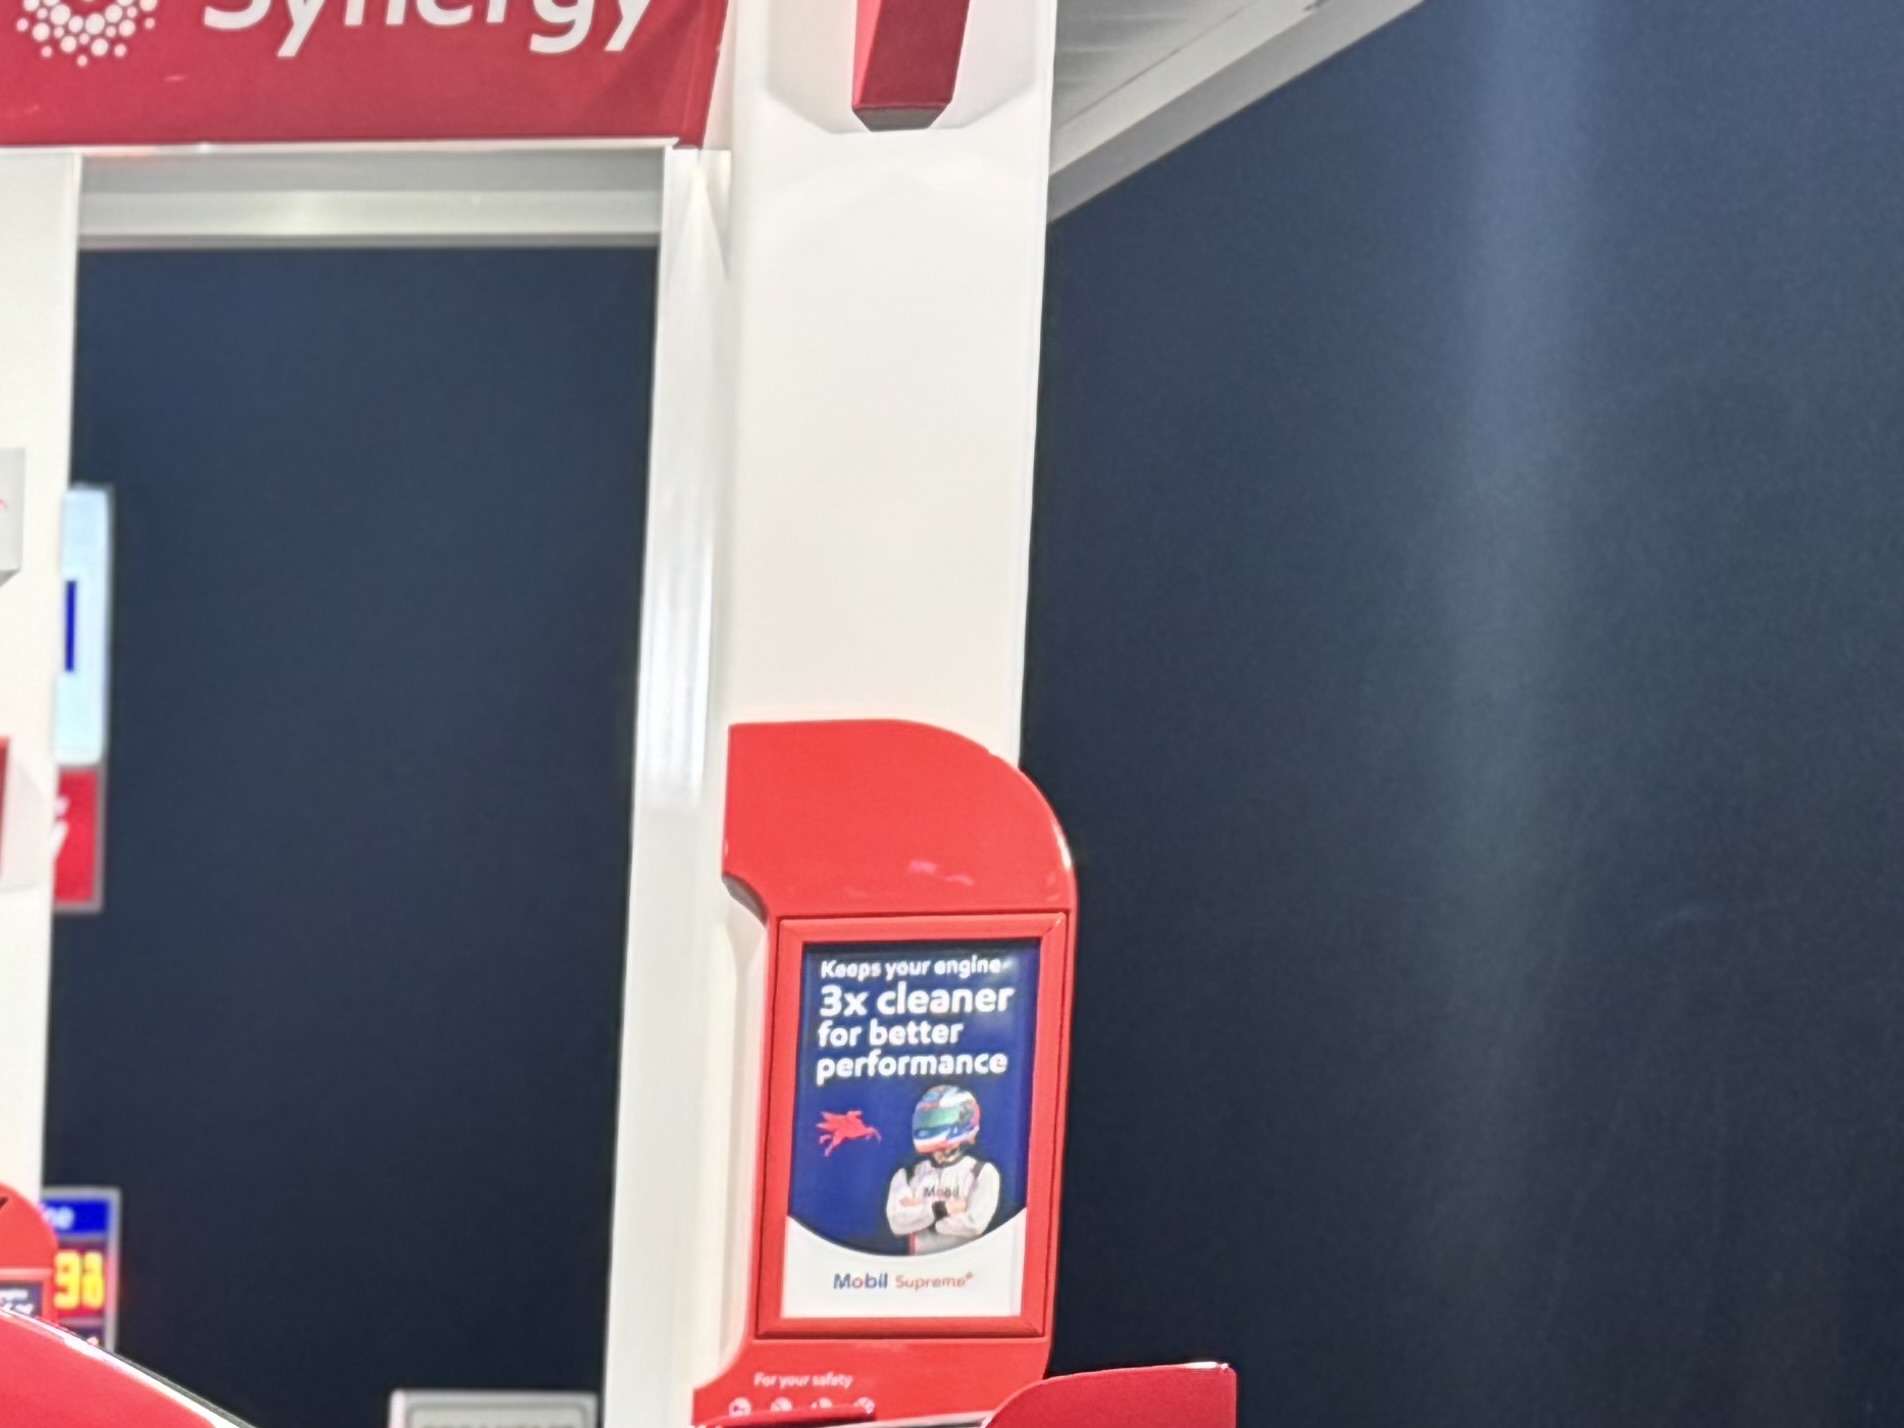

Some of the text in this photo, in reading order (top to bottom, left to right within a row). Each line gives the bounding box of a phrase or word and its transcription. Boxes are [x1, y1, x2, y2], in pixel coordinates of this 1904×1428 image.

[820, 954, 1002, 982] Keeps your engine
[819, 981, 1016, 1017] 3x cleaner
[817, 1018, 964, 1048] for better
[816, 1049, 1008, 1087] performance
[833, 1272, 889, 1290] Mobil
[753, 1370, 855, 1389] For your safety
